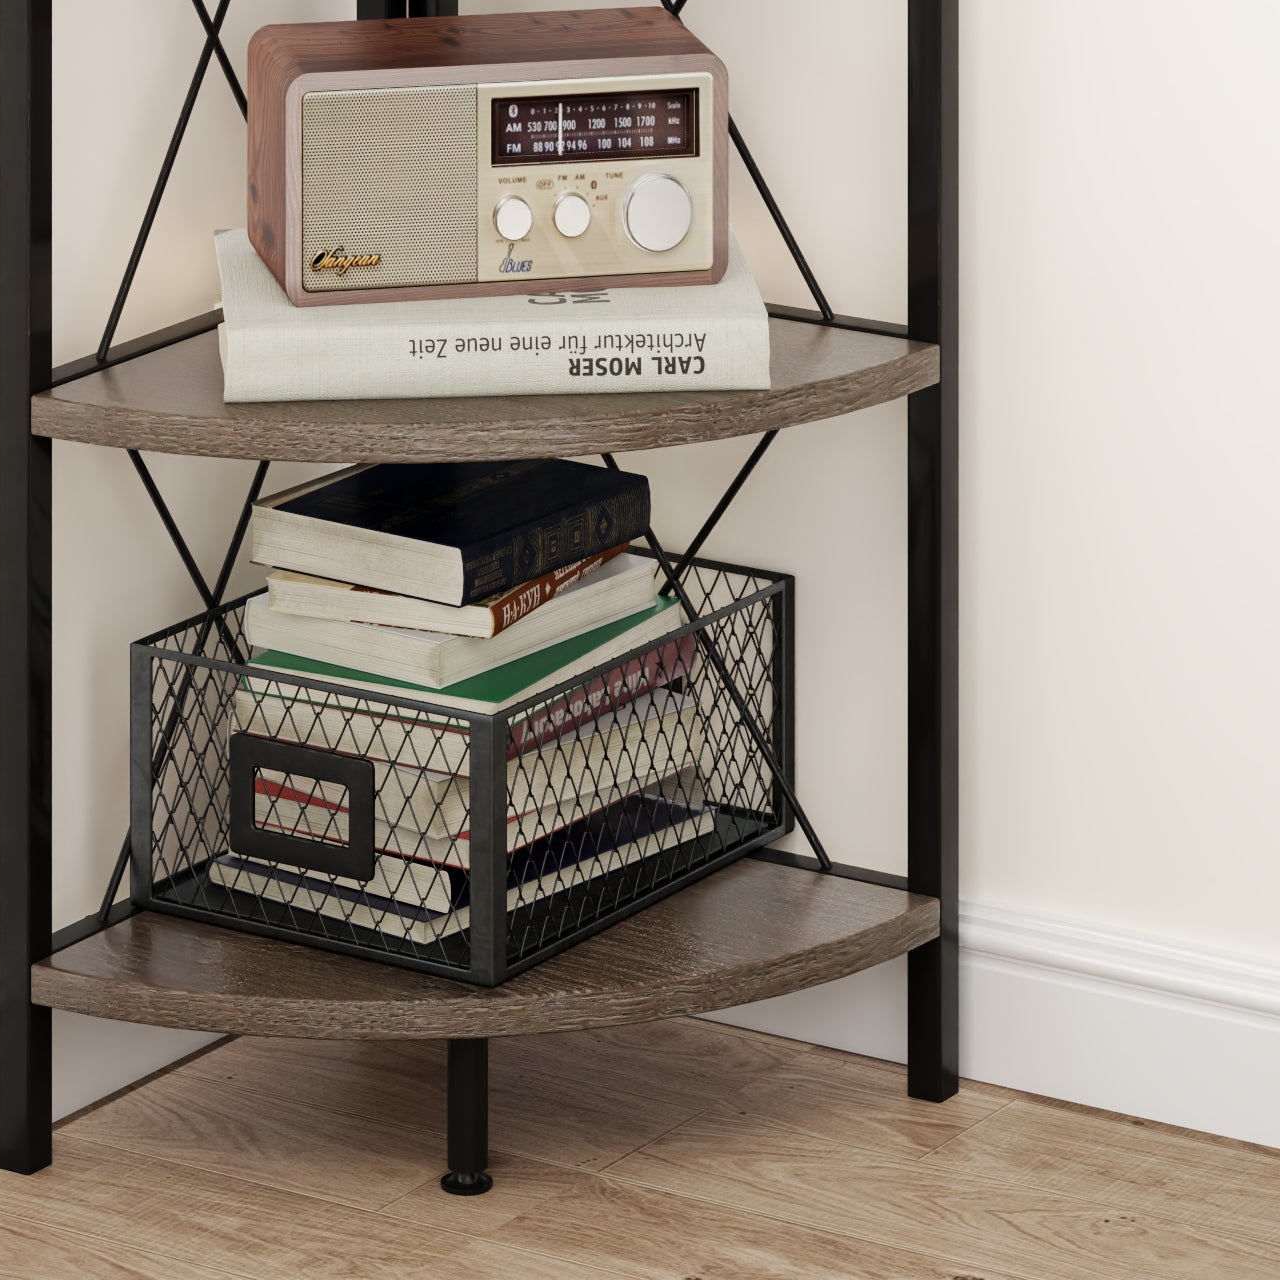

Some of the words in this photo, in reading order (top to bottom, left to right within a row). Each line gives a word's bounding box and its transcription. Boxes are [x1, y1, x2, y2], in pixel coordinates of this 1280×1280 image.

[506, 123, 522, 133] AM
[527, 121, 542, 132] 530
[544, 121, 557, 131] 700
[562, 119, 576, 130] 900
[588, 118, 606, 129] 1200
[614, 117, 632, 128] 1500
[636, 116, 656, 127] 1700
[506, 143, 522, 153] FM
[533, 142, 543, 153] 88
[544, 141, 554, 152] 90
[566, 140, 576, 151] 94
[577, 140, 587, 150] 96
[597, 138, 611, 149] 100
[618, 137, 632, 149] 104
[640, 136, 654, 147] 108
[498, 176, 527, 184] VOLUME
[409, 338, 447, 359] Zeit
[455, 336, 502, 351] neue
[510, 335, 551, 356] eine
[559, 334, 587, 354] für
[594, 332, 707, 353] Architektur
[569, 357, 642, 376] MOSER
[651, 355, 706, 375] CARL
